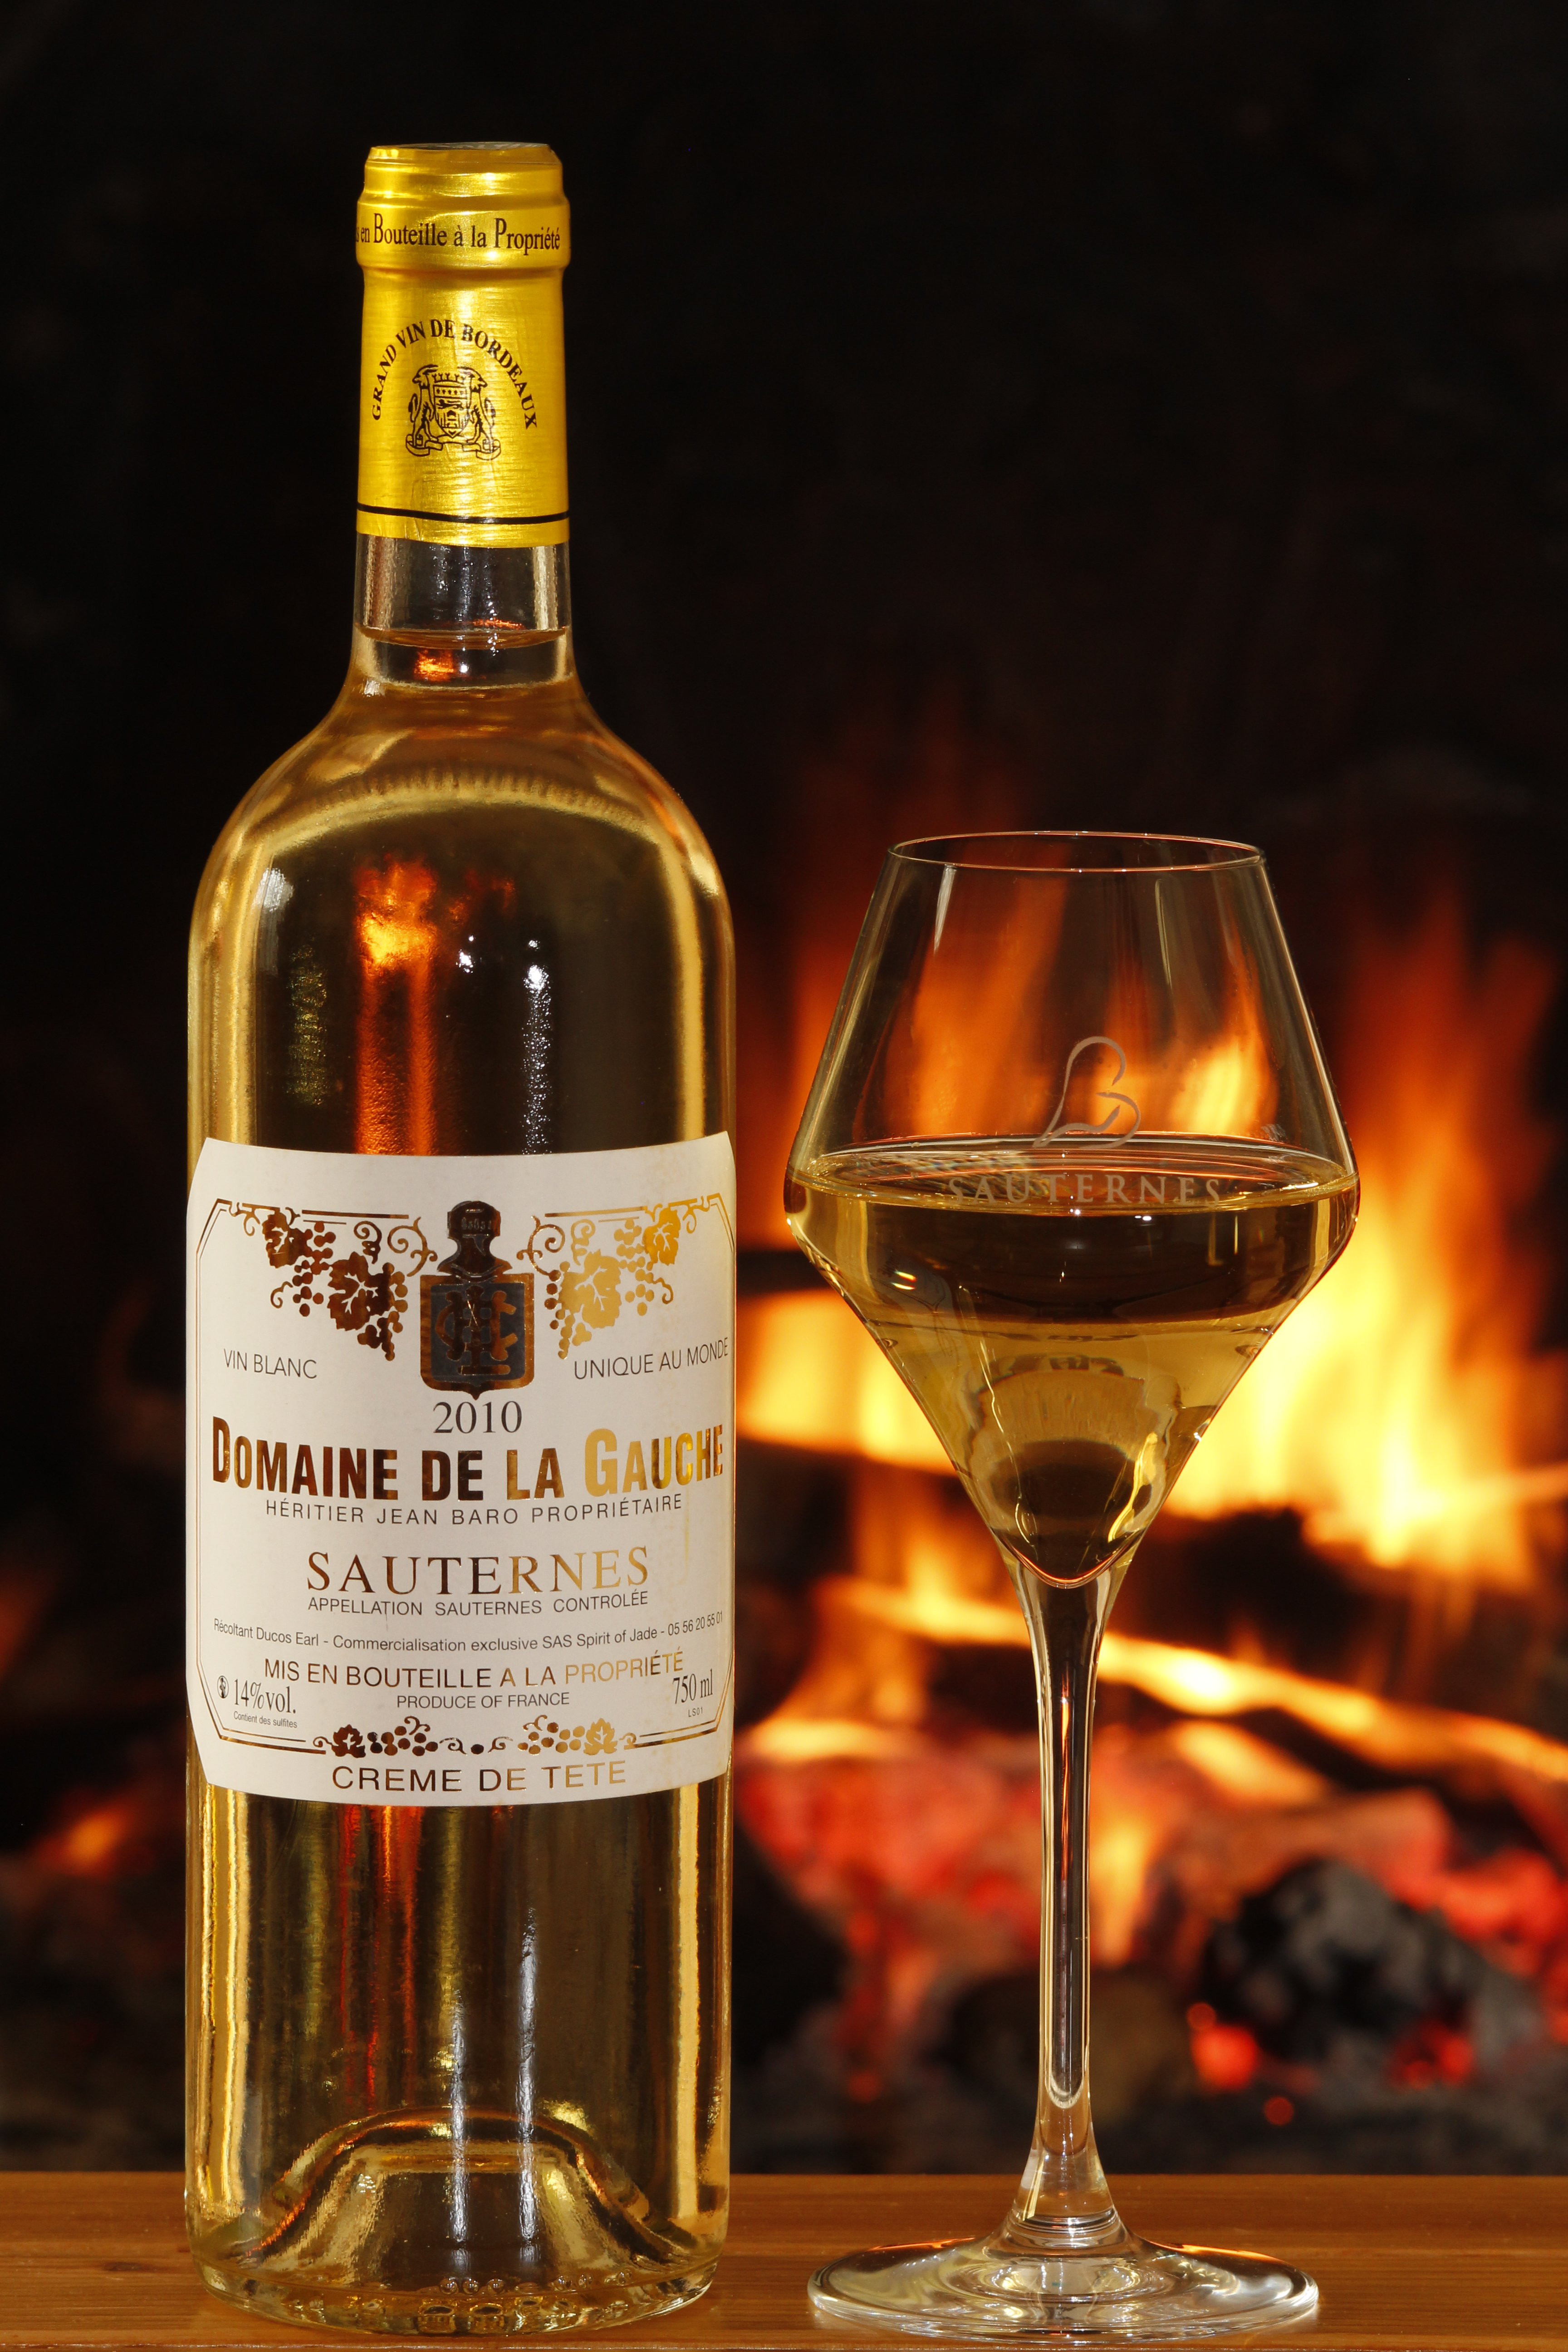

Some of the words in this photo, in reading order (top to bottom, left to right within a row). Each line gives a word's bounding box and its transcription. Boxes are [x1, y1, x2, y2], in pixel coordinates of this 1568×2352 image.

[361, 227, 370, 243] en
[373, 213, 447, 246] Bouteille
[454, 225, 463, 246] à
[471, 225, 487, 247] la
[495, 218, 560, 255] Propriété
[372, 344, 397, 420] GRAND
[396, 321, 426, 348] VIN
[431, 319, 455, 338] DE
[461, 323, 538, 430] BORDEAUX
[948, 1173, 1220, 1208] SAUTERNES
[224, 1348, 247, 1371] VIN
[254, 1354, 317, 1379] BLANC
[574, 1354, 653, 1380] UNIQUE
[659, 1350, 681, 1372] AU
[687, 1337, 728, 1367] MONDE
[433, 1401, 522, 1434] 2010
[213, 1416, 398, 1501] DOMAINE
[421, 1450, 483, 1501] DE
[507, 1448, 565, 1500] LA
[584, 1424, 723, 1497] GAUCHE
[266, 1498, 364, 1523] HÉRITIER
[377, 1509, 437, 1525] JEAN
[452, 1509, 518, 1525] BARO
[532, 1494, 681, 1523] PROPRIÉTAIRE
[307, 1545, 648, 1595] SAUTERNES
[308, 1597, 422, 1616] APPELLATION
[435, 1600, 542, 1616] SAUTERNES
[553, 1589, 648, 1612] CONTROLÉE
[214, 1618, 253, 1639] Récoltant
[257, 1627, 292, 1643] Ducos
[296, 1632, 318, 1646] Earl
[333, 1635, 466, 1652] Commercialisation
[471, 1638, 538, 1651] exclusive
[543, 1635, 573, 1649] SAS
[577, 1632, 611, 1648] Spirit
[614, 1629, 627, 1643] of
[630, 1627, 657, 1642] Jade
[668, 1622, 680, 1636] 05
[683, 1620, 693, 1633] 56
[696, 1617, 705, 1630] 20
[707, 1613, 715, 1627] 55
[716, 1610, 723, 1623] 01
[265, 1658, 299, 1681] MIS
[308, 1663, 337, 1685] EN
[347, 1666, 491, 1688] BOUTEILLE
[500, 1668, 516, 1687] A
[525, 1666, 556, 1687] LA
[565, 1646, 683, 1685] PROPRIÉTÉ
[397, 1695, 476, 1709] PRODUCE
[481, 1695, 503, 1708] OF
[508, 1692, 570, 1707] FRANCE
[672, 1673, 696, 1704] 750
[700, 1668, 713, 1698] ml
[234, 1710, 258, 1723] Contient
[259, 1715, 271, 1725] des
[273, 1719, 298, 1728] sulfites
[332, 1766, 462, 1792] CREME
[479, 1769, 526, 1792] DE
[541, 1760, 626, 1789] TETE
